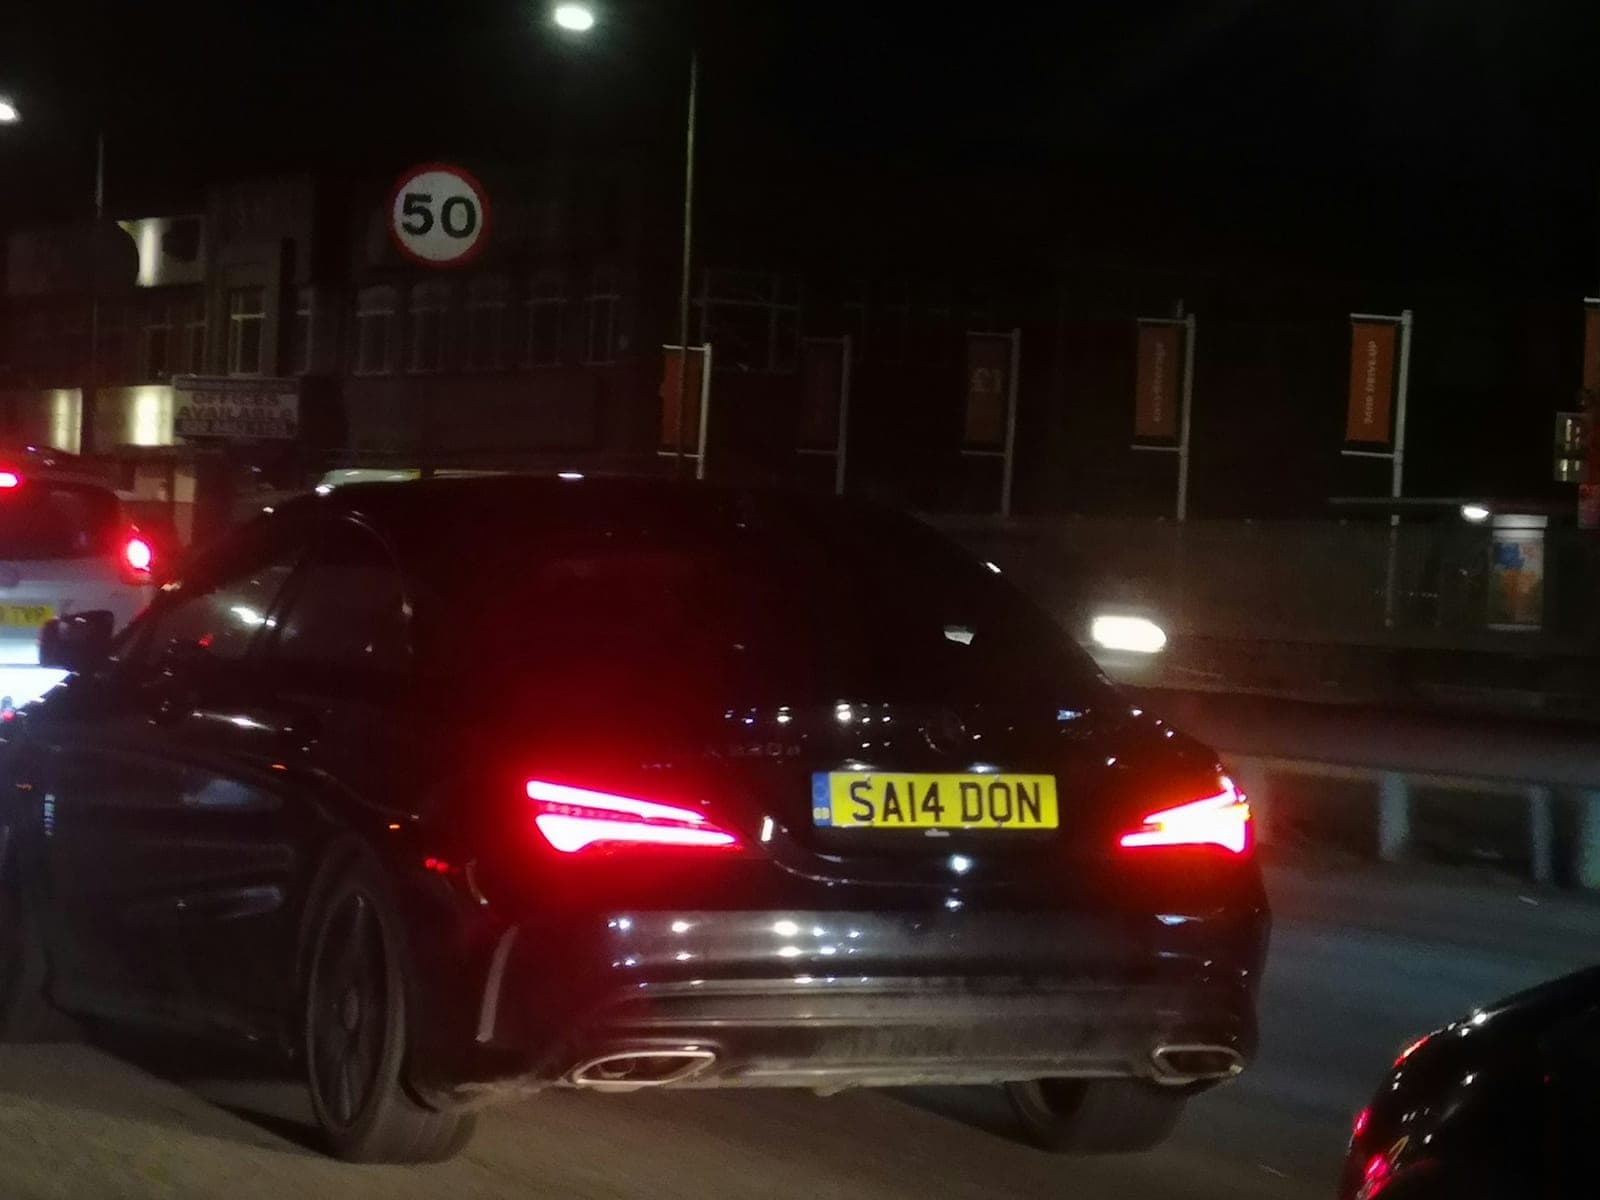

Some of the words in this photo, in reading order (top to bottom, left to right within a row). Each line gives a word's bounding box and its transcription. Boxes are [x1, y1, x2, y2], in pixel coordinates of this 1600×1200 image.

[402, 193, 477, 239] 50
[849, 780, 945, 823] SA14
[959, 781, 1042, 823] DON
